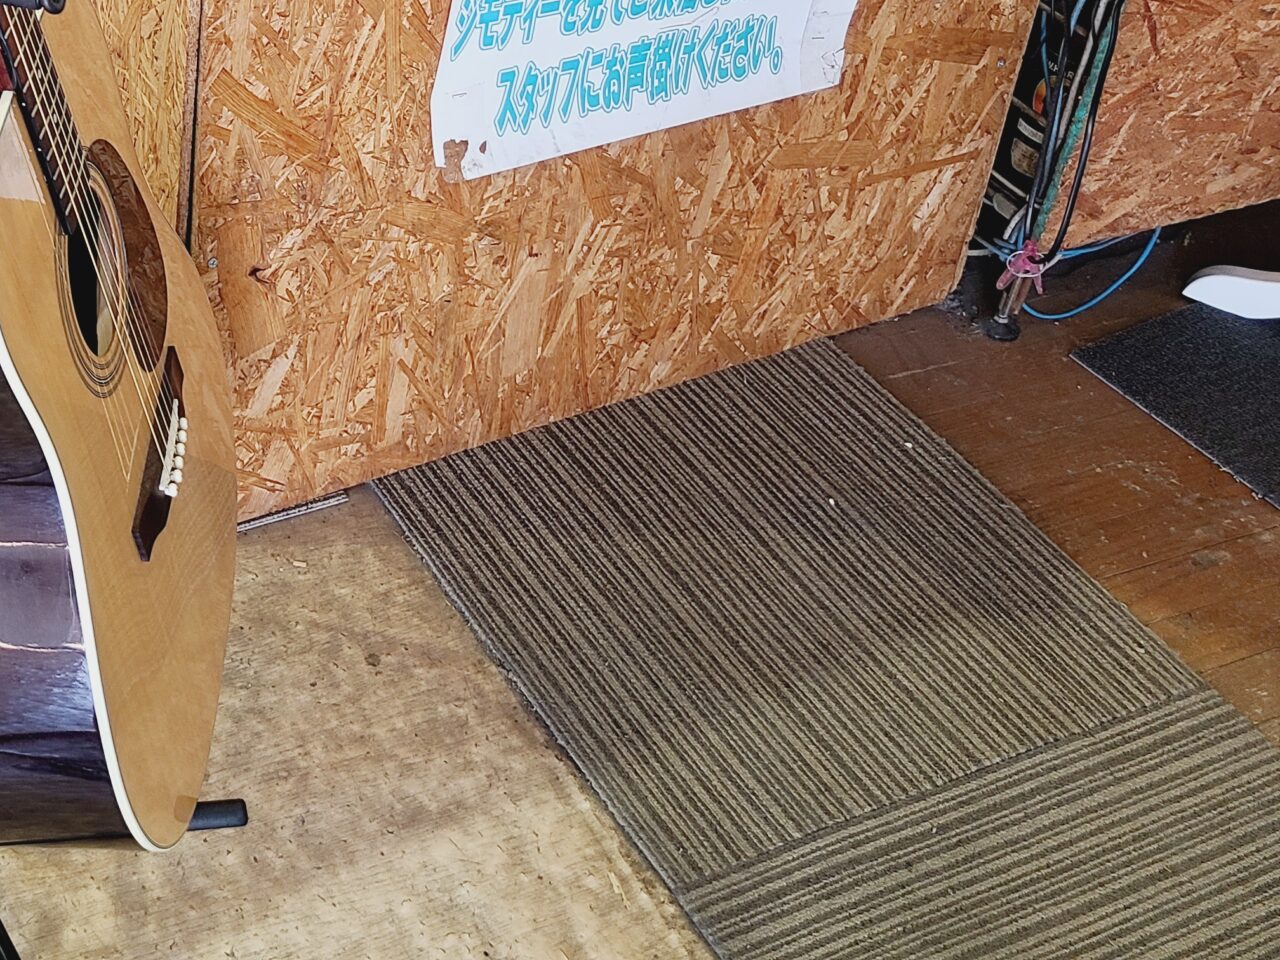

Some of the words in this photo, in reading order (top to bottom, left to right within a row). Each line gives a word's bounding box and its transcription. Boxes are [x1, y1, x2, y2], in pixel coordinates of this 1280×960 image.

[495, 15, 783, 136] スタッフにお声掛けください。
